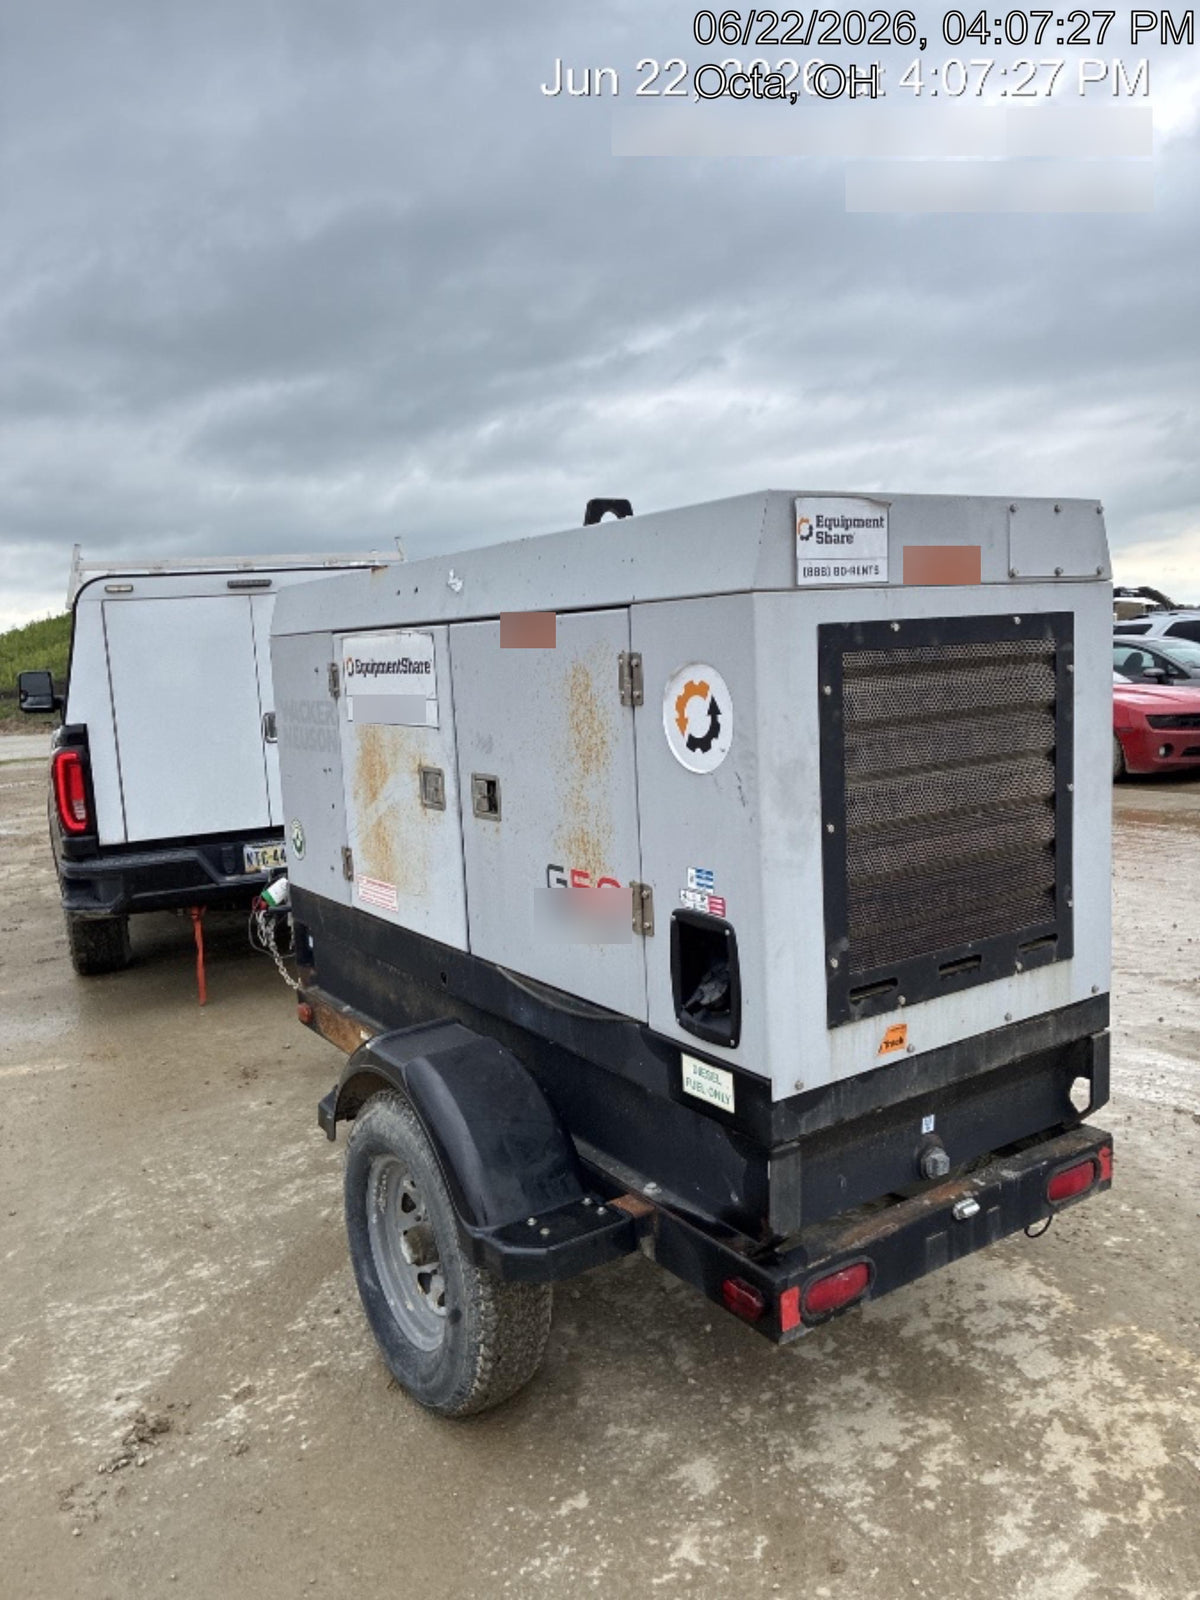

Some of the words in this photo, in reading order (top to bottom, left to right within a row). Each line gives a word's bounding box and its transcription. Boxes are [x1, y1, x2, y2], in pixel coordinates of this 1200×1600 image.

[815, 514, 885, 531] Equipment
[815, 531, 854, 545] Share
[354, 656, 431, 678] EquipmentShare
[692, 1064, 722, 1086] DIESEL
[685, 1076, 706, 1095] FUEL
[708, 1086, 731, 1105] ONLY
